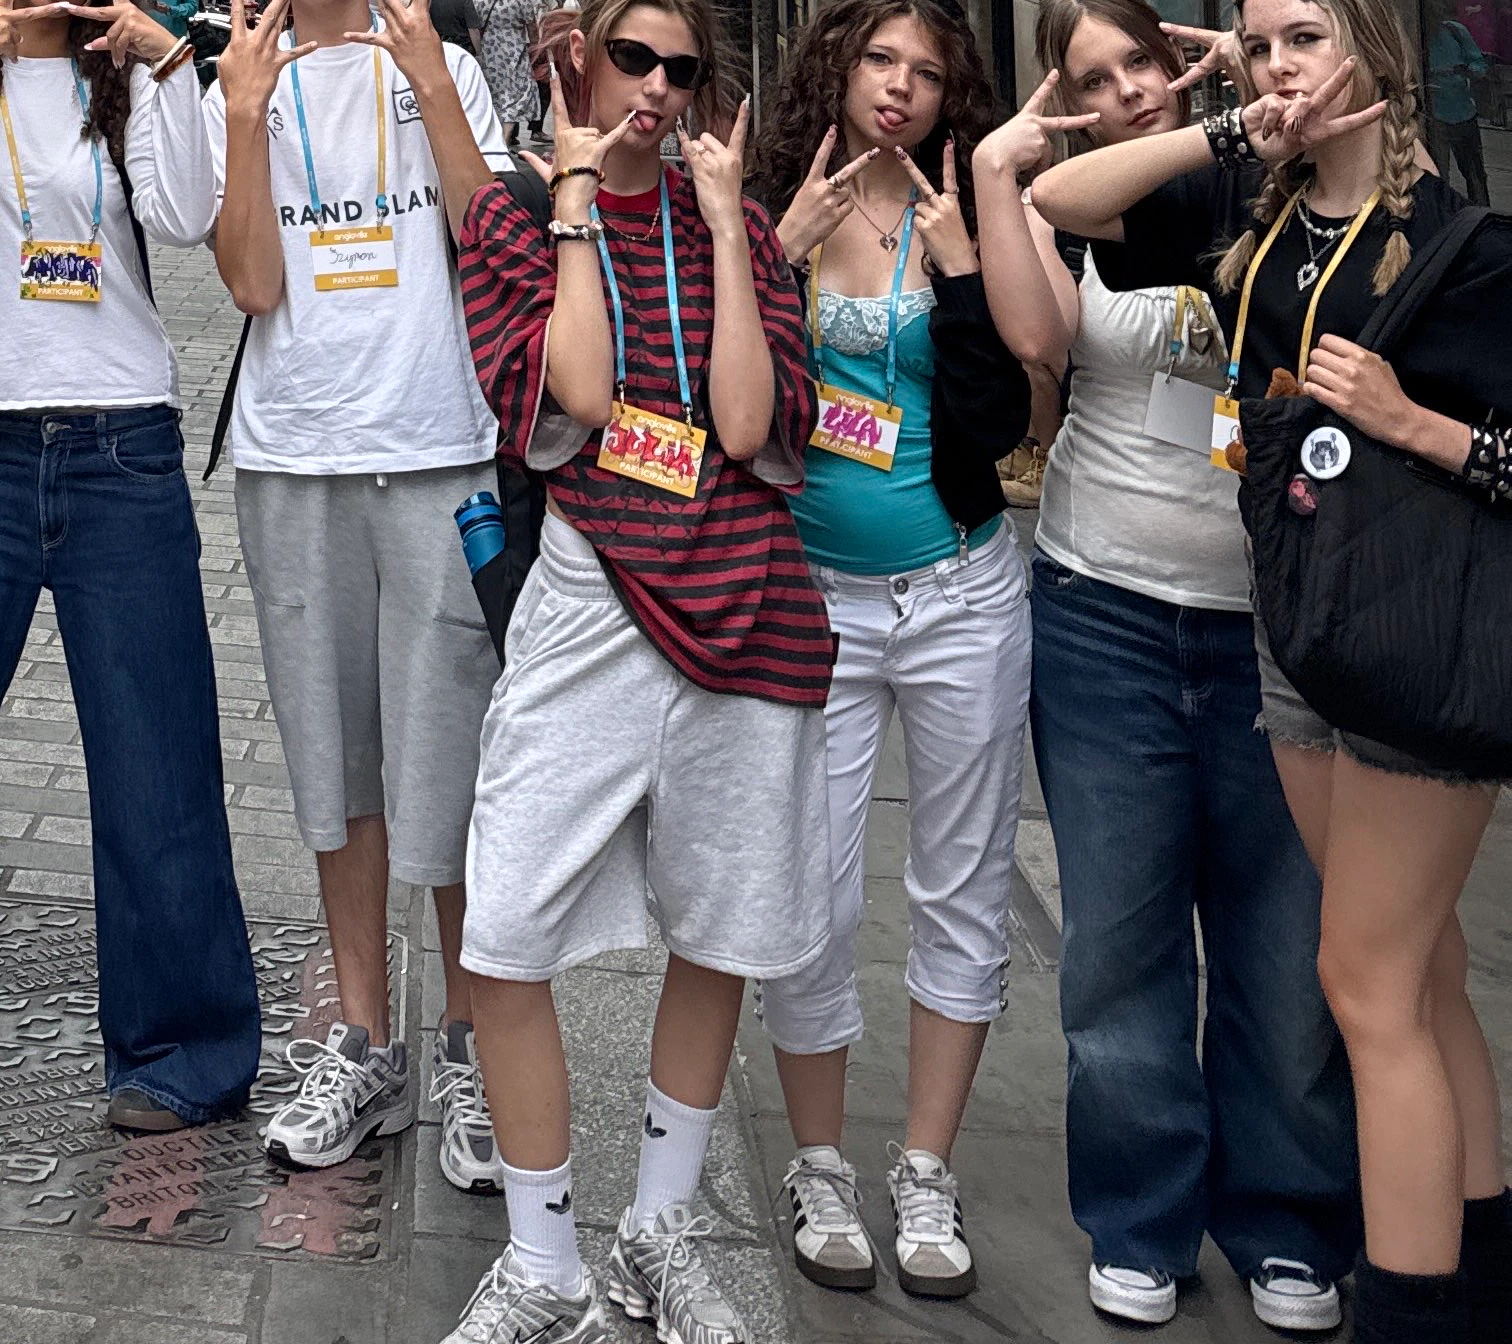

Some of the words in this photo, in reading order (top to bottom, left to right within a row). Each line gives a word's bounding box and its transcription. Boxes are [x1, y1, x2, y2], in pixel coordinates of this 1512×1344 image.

[279, 199, 364, 228] RAND
[332, 273, 380, 286] PARTICIPANT
[619, 462, 675, 486] PARTICIPANT
[122, 1127, 252, 1161] DUCTILE
[109, 1178, 221, 1210] BRITON
